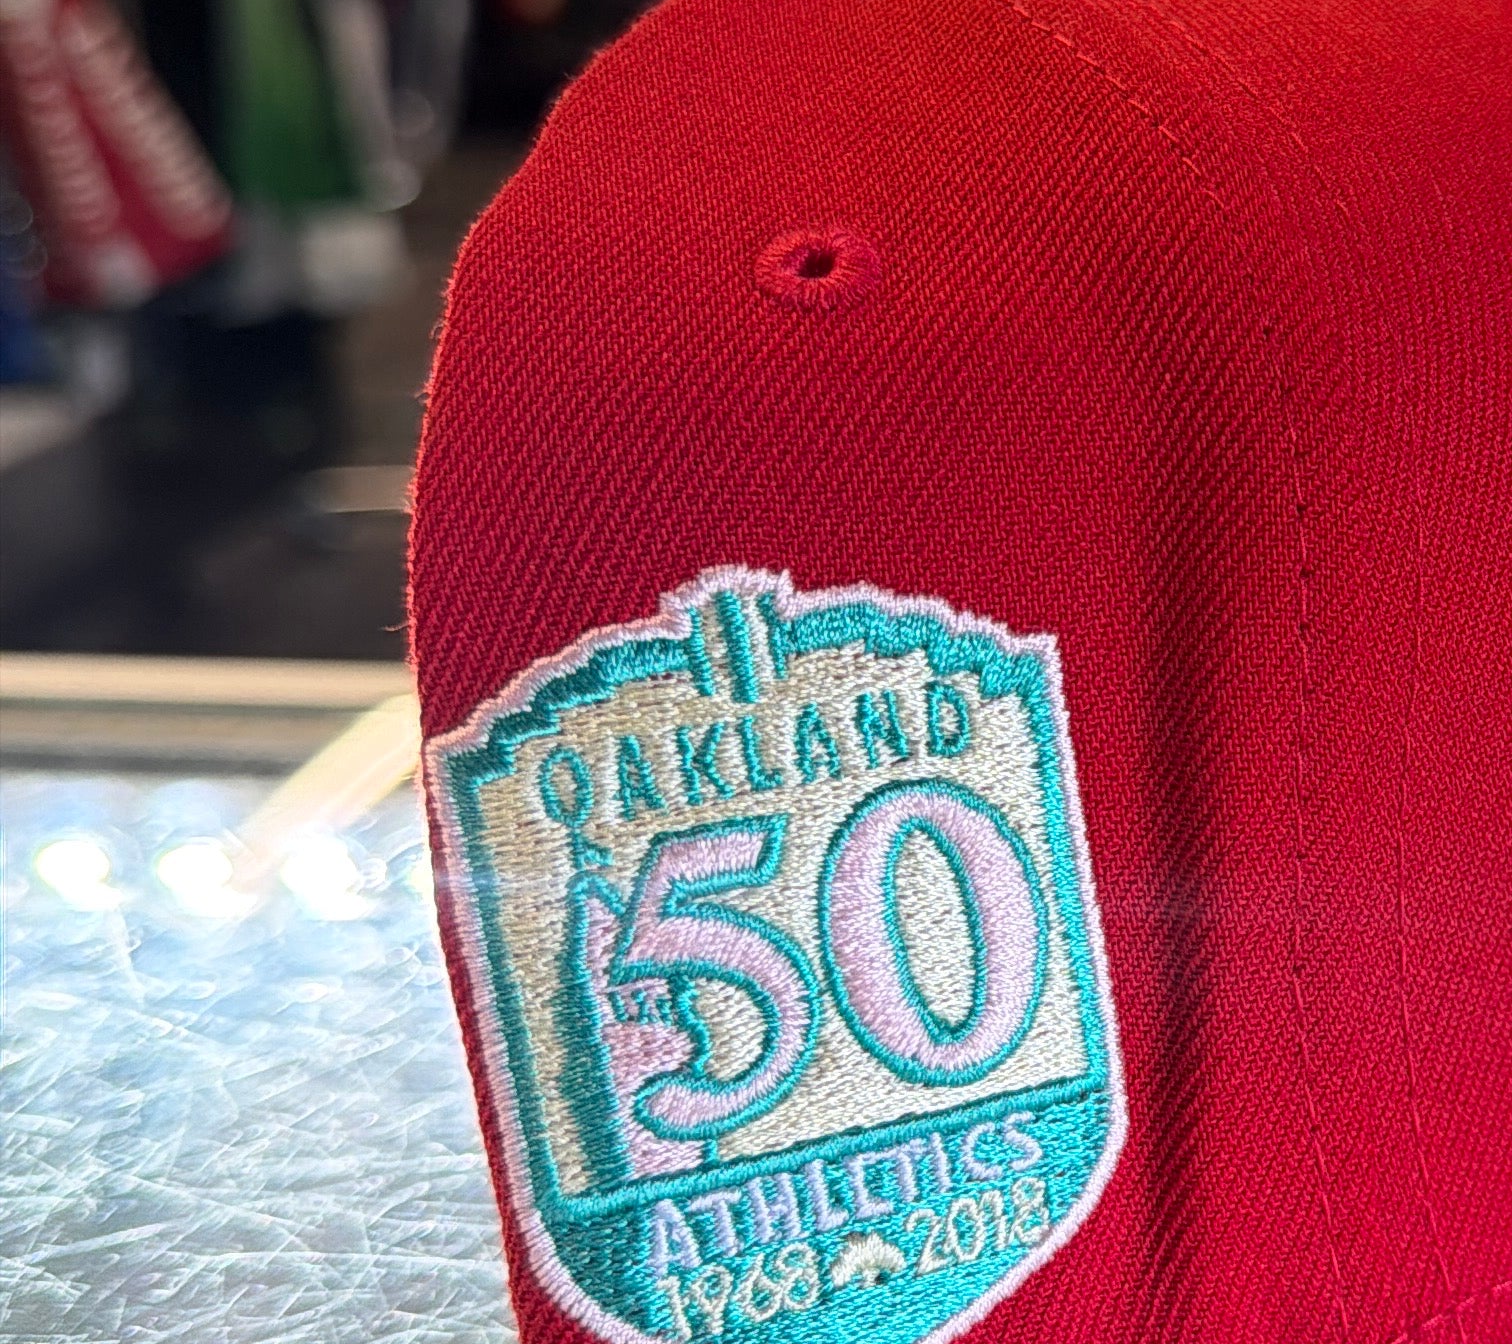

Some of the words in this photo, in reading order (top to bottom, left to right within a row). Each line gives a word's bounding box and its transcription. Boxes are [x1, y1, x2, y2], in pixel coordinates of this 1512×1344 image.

[539, 683, 970, 829] OAKLAND
[608, 780, 1049, 1140] 50
[645, 1111, 1043, 1270] ATHLETICS
[655, 1246, 817, 1340] 1968
[902, 1182, 1048, 1274] 2018
